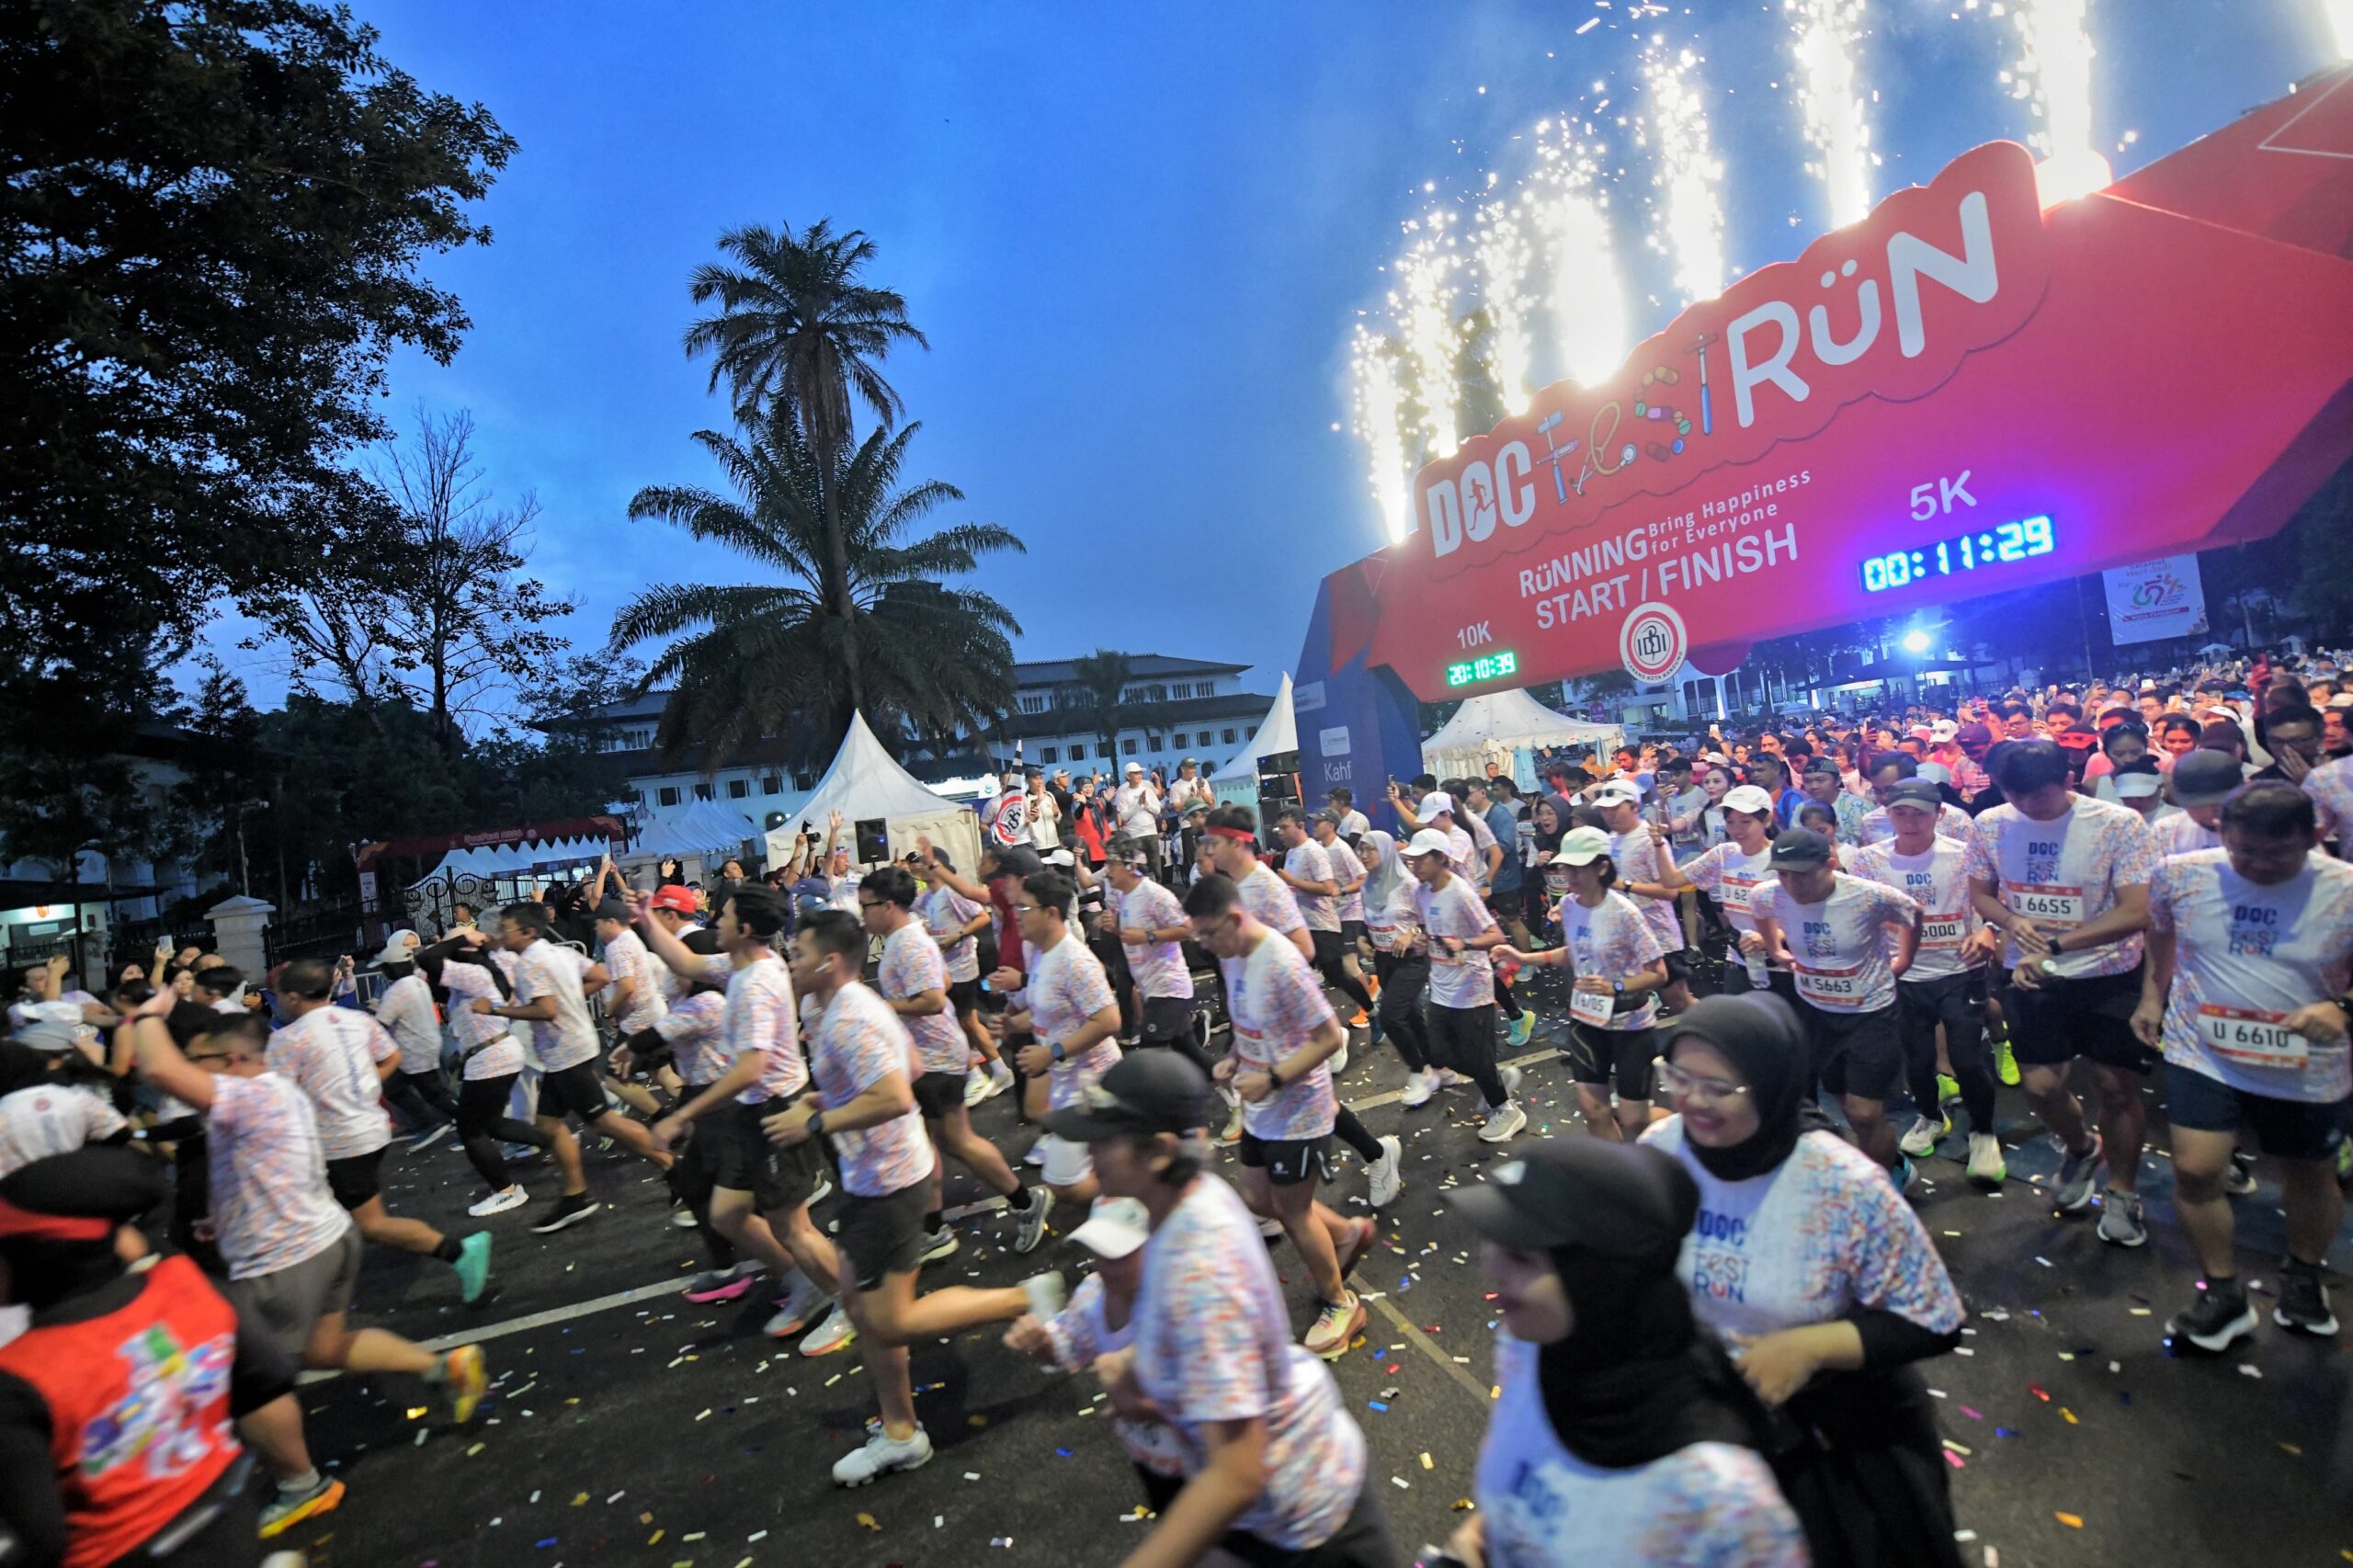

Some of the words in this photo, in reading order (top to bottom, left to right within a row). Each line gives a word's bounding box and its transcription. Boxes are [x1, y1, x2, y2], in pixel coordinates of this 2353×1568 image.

[1426, 440, 1536, 559] DOC
[1648, 512, 1696, 538] Bring
[1702, 470, 1811, 518] Happiness
[1910, 470, 1977, 521] 5K
[1651, 530, 1679, 555] for
[1685, 503, 1779, 544] Everyone
[1863, 515, 2054, 593] 00:11:29
[1536, 574, 1631, 630] START
[1657, 522, 1798, 597] FINISH
[1457, 620, 1493, 649] 10K
[1627, 661, 1646, 680] CABANG
[1663, 651, 1683, 677] BANDUNG
[1324, 761, 1352, 782] Kahf
[2029, 841, 2058, 856] DOC
[1906, 873, 1932, 885] DOC
[2027, 897, 2072, 915] 6655
[2234, 905, 2278, 926] DOC
[1803, 922, 1832, 935] DOC
[1814, 978, 1852, 993] 5663
[2213, 1021, 2226, 1040] U
[2236, 1025, 2290, 1048] 6610
[1699, 1210, 1745, 1246] DOC
